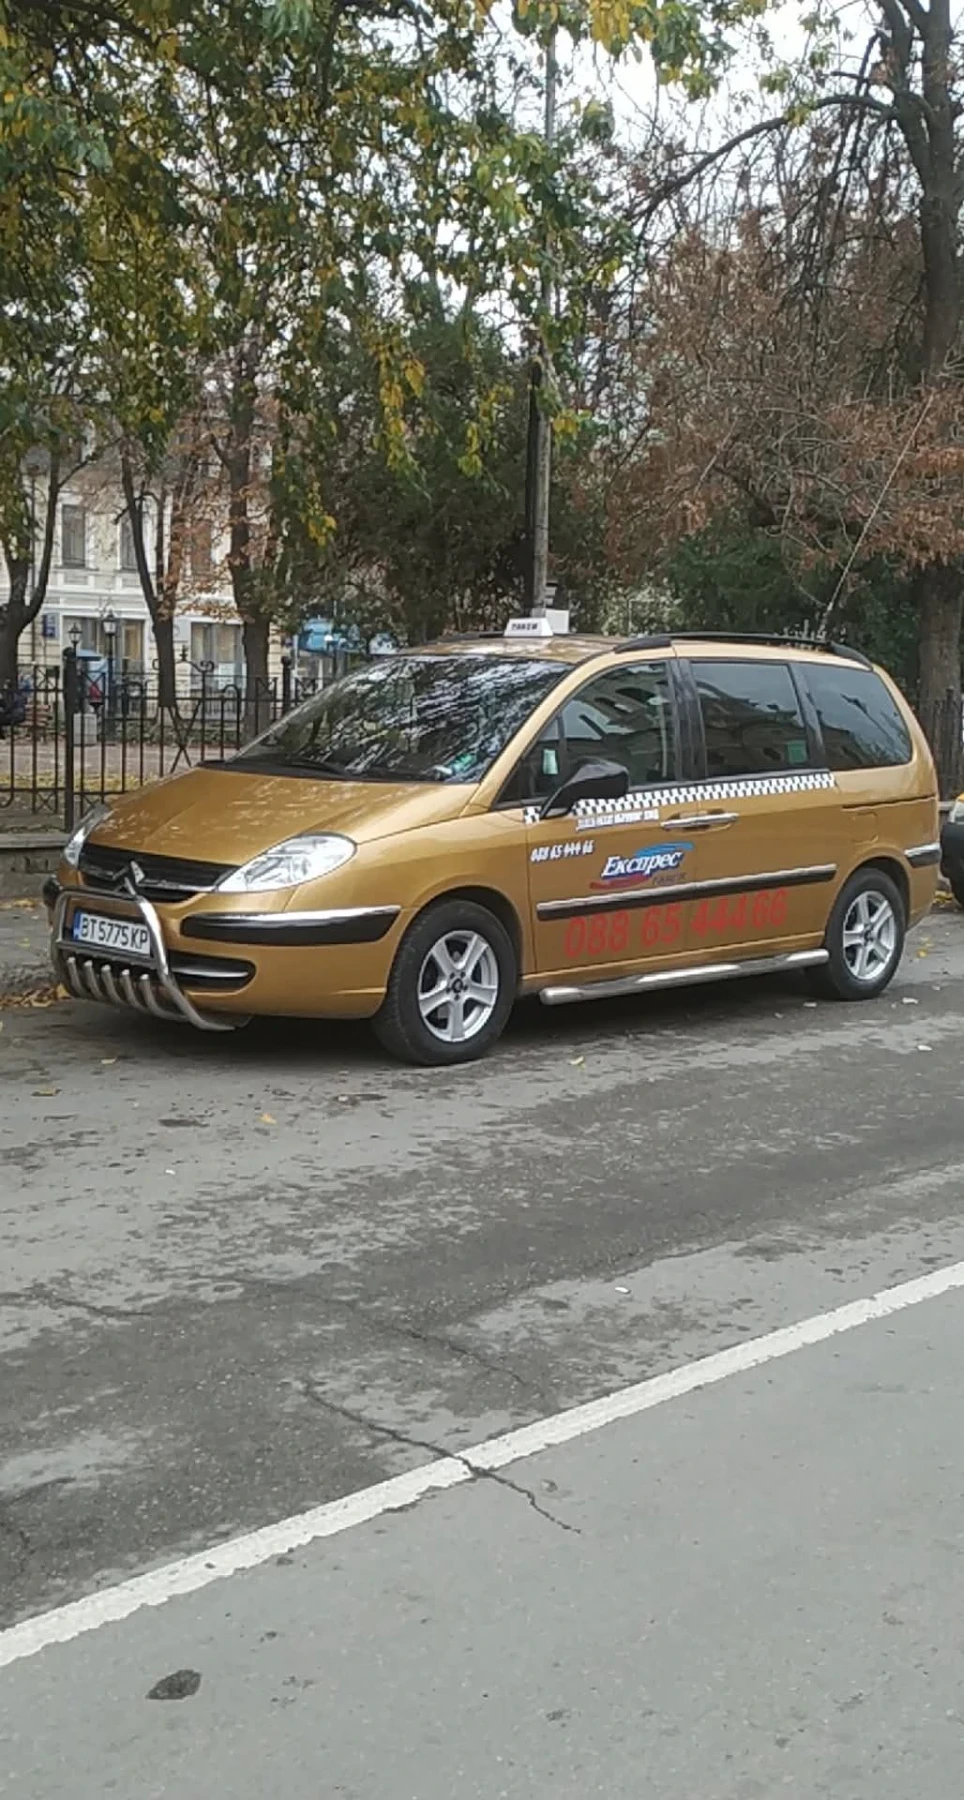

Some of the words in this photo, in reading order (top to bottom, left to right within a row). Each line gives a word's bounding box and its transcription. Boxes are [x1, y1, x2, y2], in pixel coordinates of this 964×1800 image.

[601, 851, 683, 877] Експрес
[564, 909, 630, 958] 088
[641, 902, 683, 946] 65
